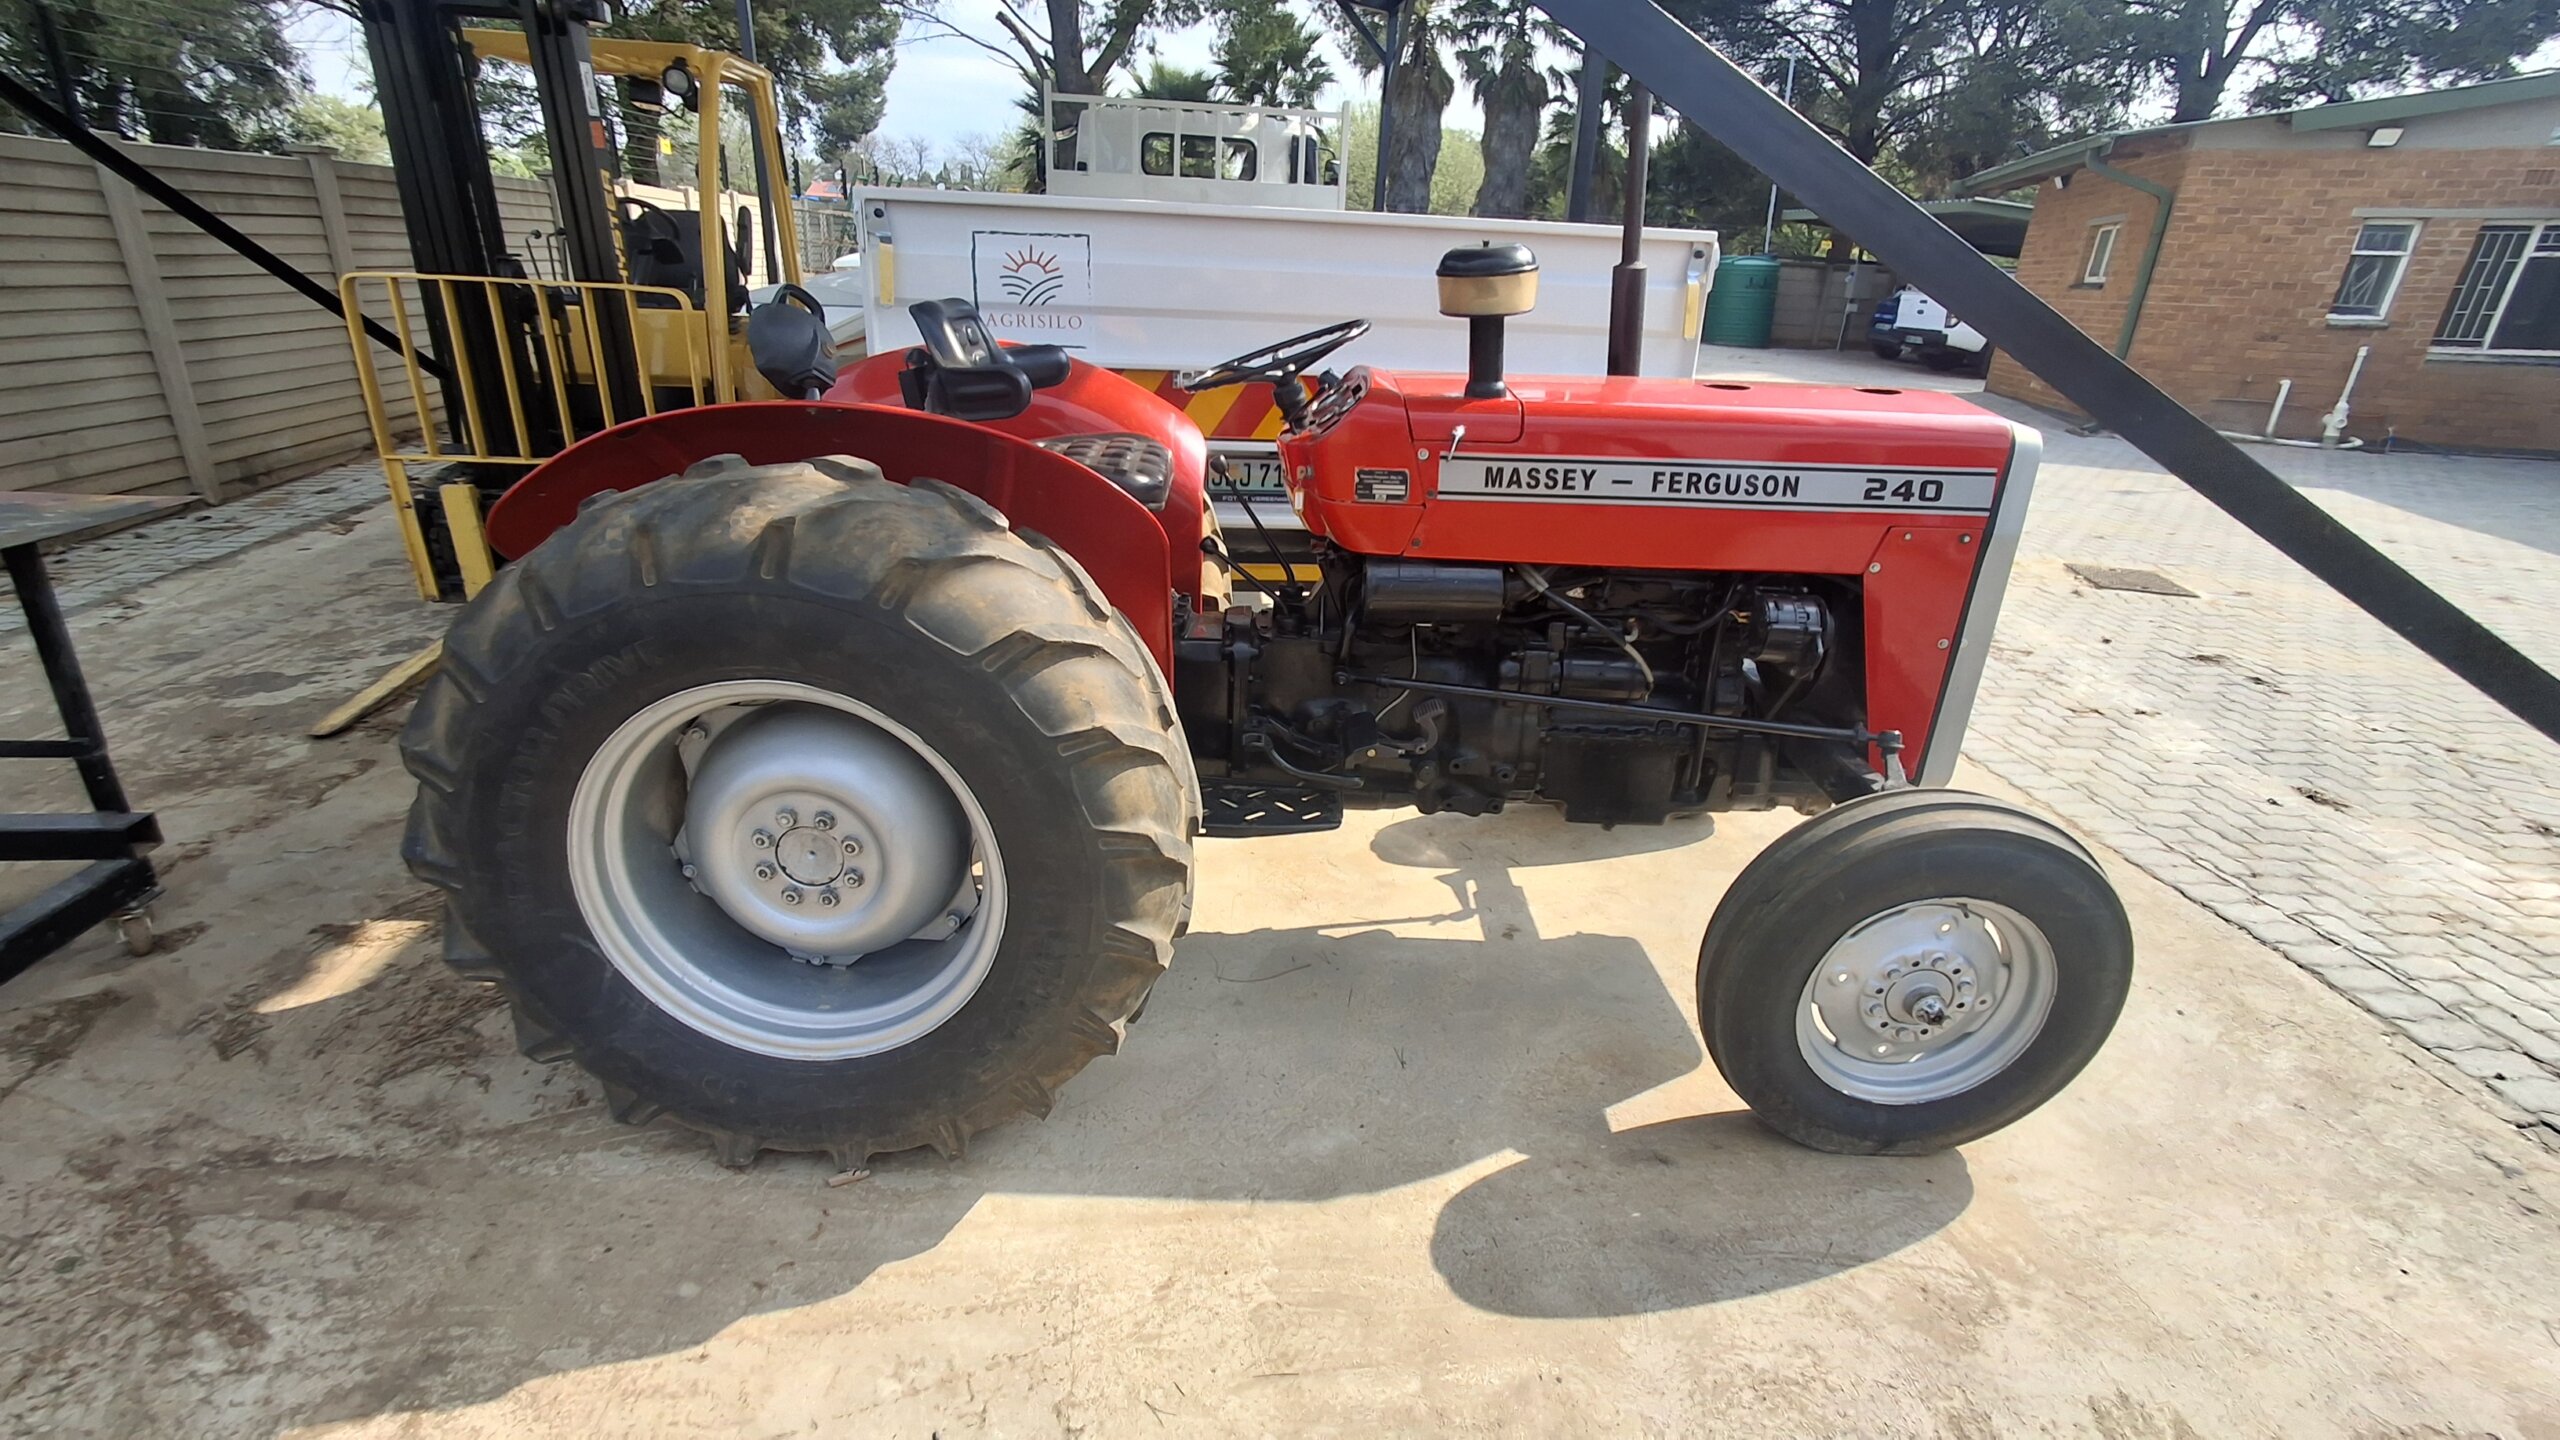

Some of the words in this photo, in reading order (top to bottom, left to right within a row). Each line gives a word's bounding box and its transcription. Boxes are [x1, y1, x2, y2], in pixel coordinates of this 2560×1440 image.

[986, 312, 1083, 330] AGRISILO
[1484, 466, 1598, 491] MASSEY
[1651, 471, 1800, 498] FERGUSON
[1863, 477, 1944, 502] 240
